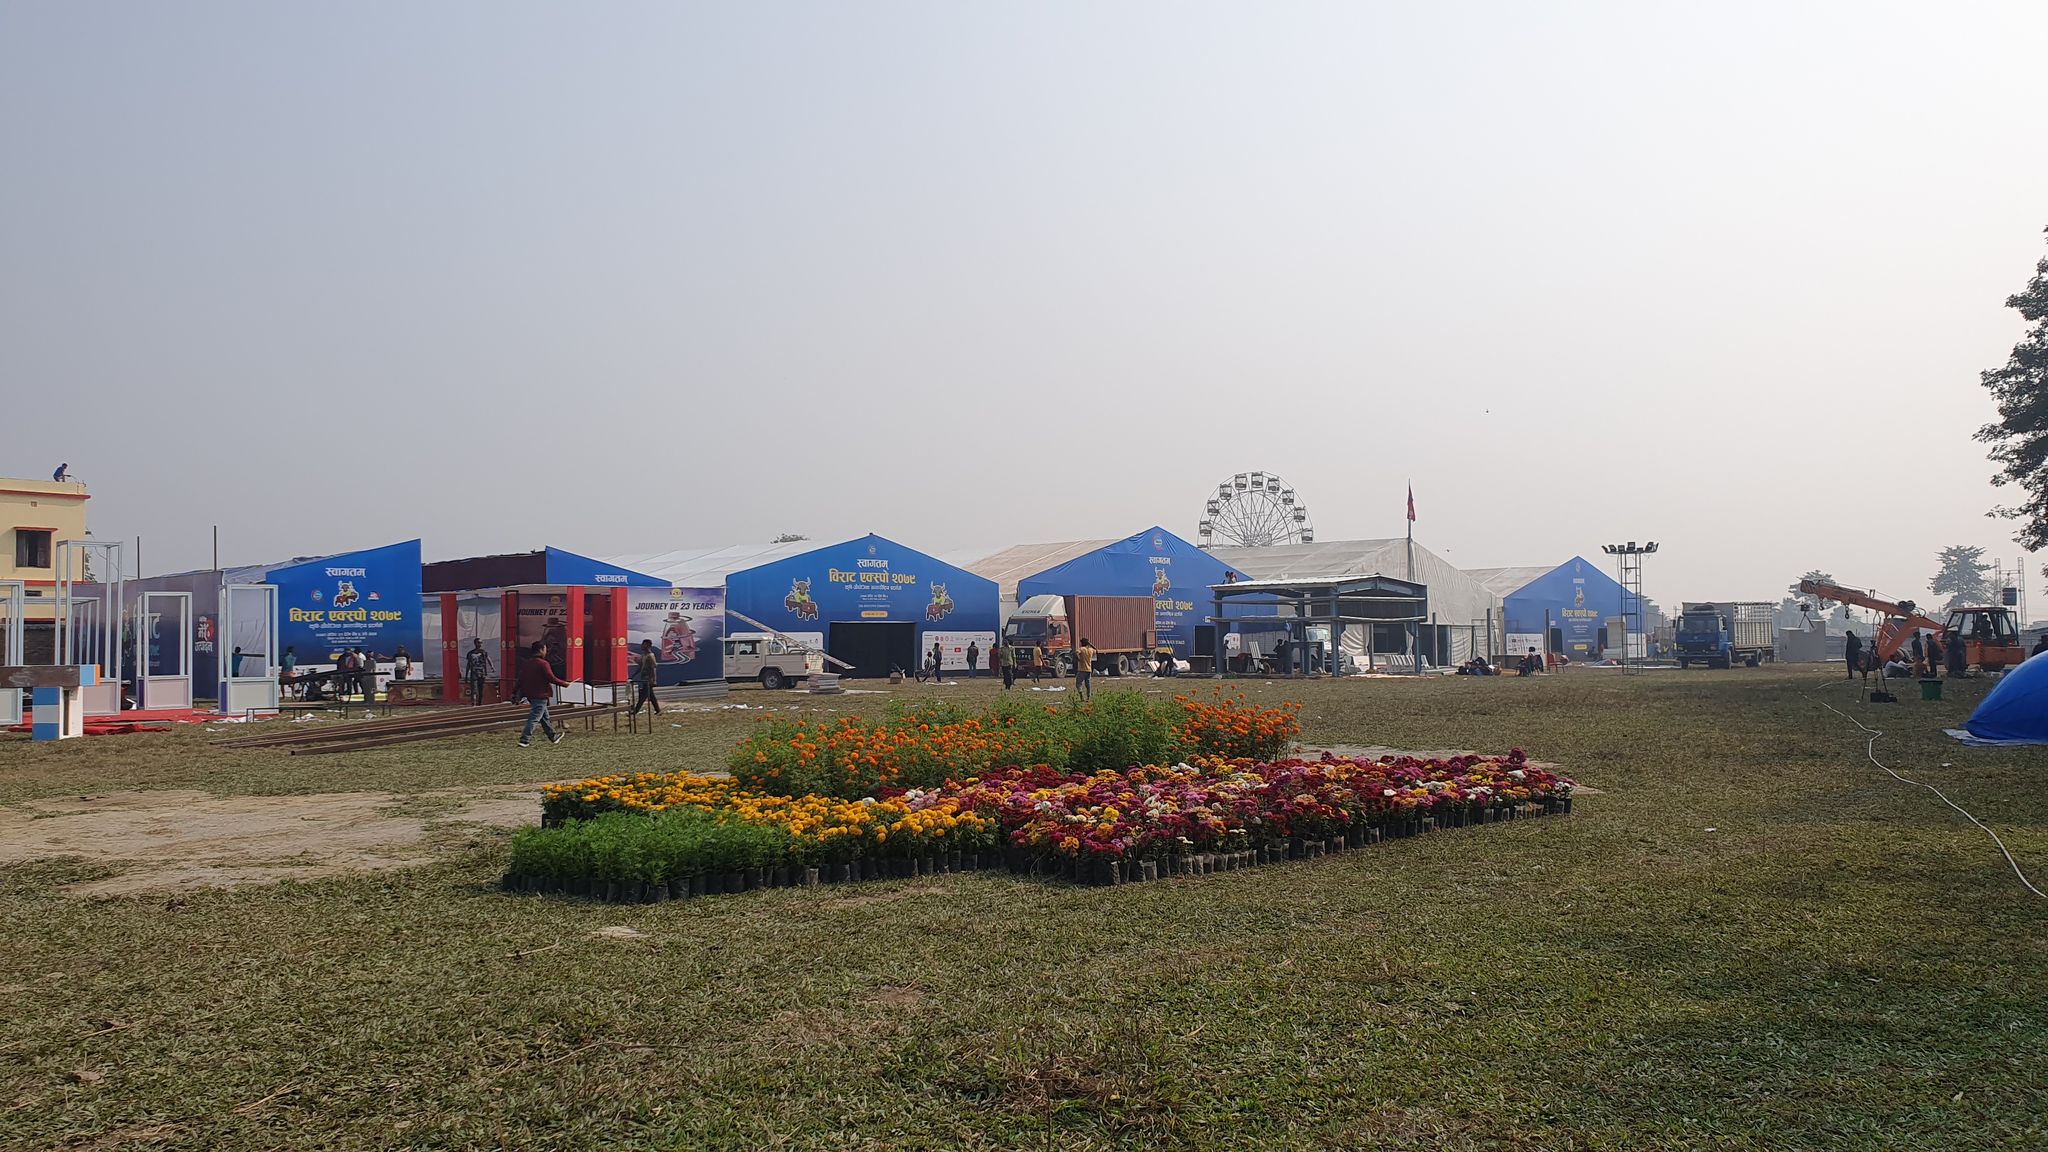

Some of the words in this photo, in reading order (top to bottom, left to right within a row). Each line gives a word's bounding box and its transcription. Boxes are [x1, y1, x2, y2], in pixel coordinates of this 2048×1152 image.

[856, 559, 889, 570] स्वागतम्
[325, 567, 367, 578] स्वागतम्
[829, 568, 856, 583] विराट
[859, 569, 889, 583] एक्स्पो
[594, 574, 629, 584] स्वागतम्
[635, 602, 668, 610] JOURNEY
[669, 602, 680, 610] OF
[680, 602, 691, 610] 23
[289, 608, 325, 622] विराट
[328, 608, 367, 621] एक्स्पो
[370, 610, 402, 621] २०७९
[517, 608, 549, 616] JOURNEY
[550, 608, 557, 616] OF
